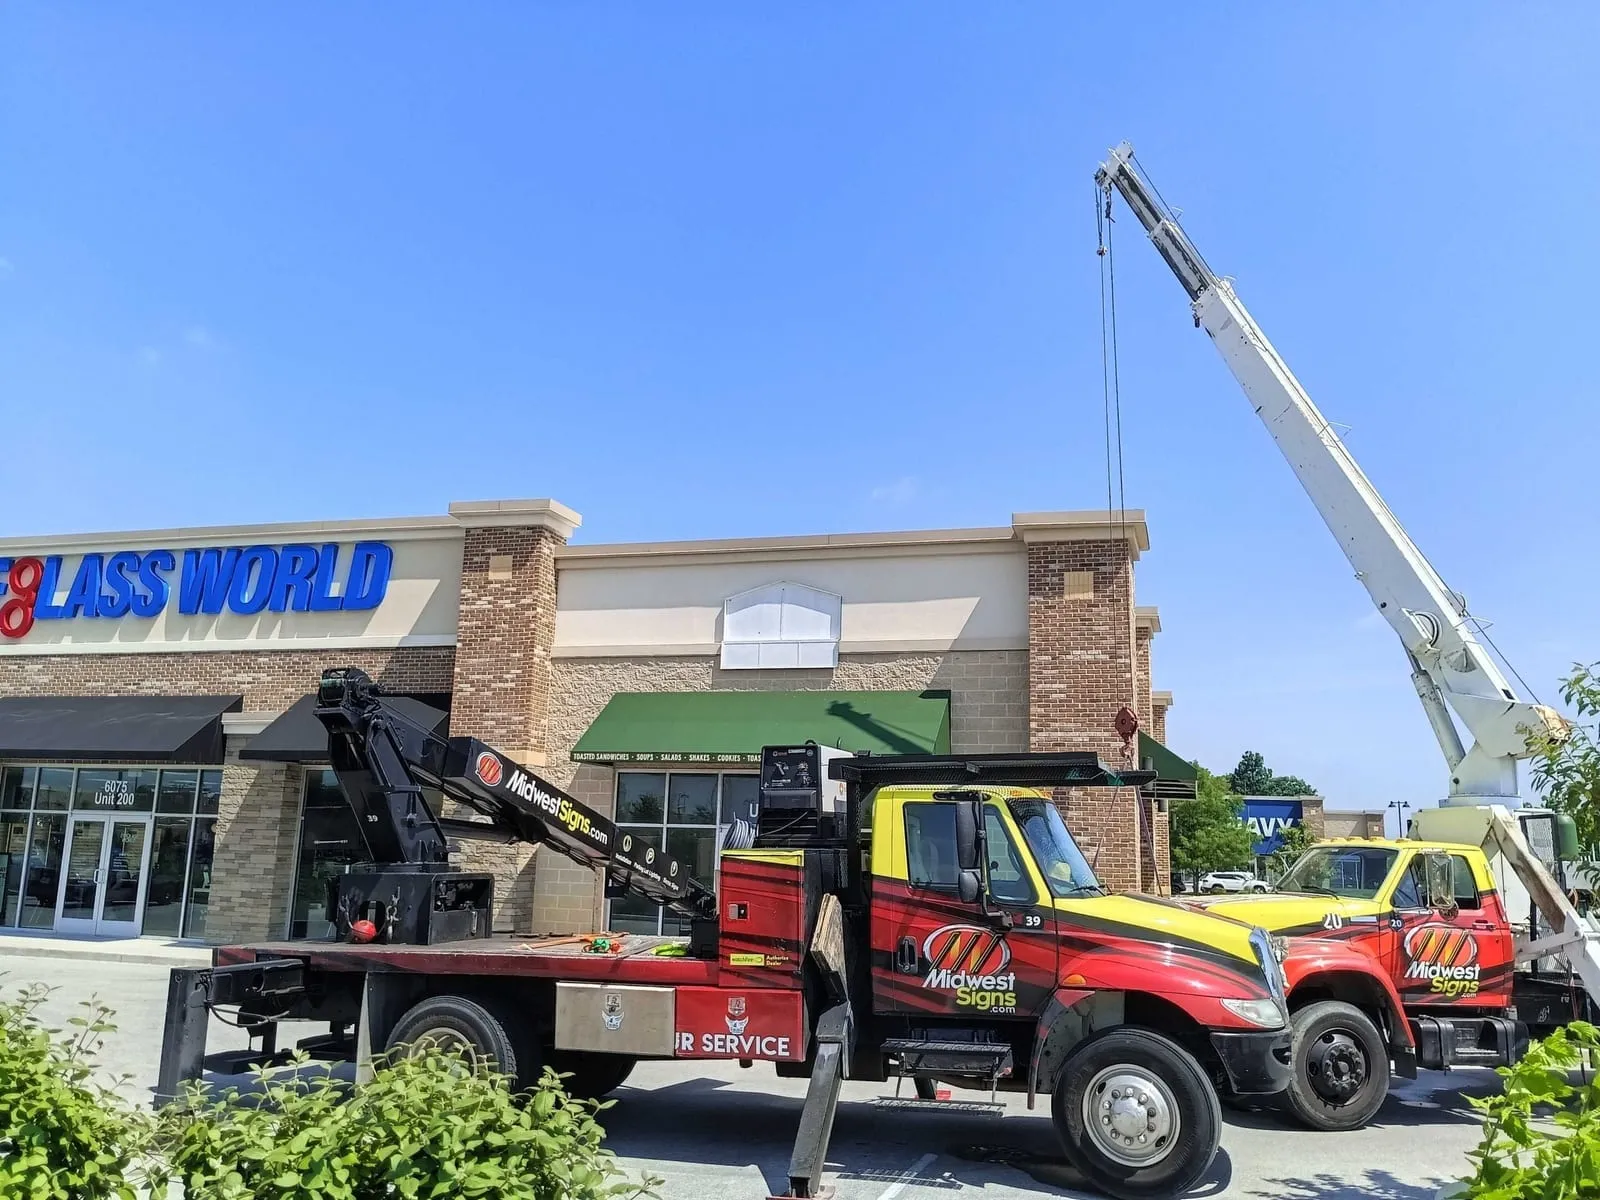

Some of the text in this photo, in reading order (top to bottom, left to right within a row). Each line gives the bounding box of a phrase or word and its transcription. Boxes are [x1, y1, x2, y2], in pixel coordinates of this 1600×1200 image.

[179, 540, 393, 614] WORLD
[596, 753, 629, 761] SANDWICHES
[636, 753, 654, 761] SOUPS
[689, 754, 710, 762] SHAKES
[104, 780, 128, 793] 6075
[94, 792, 135, 805] Unit 200
[505, 769, 608, 845] MidwestSigns.com
[367, 814, 378, 822] 39
[1236, 816, 1293, 837] AVY
[1025, 915, 1041, 927] 39
[1391, 918, 1402, 929] 20
[922, 968, 1016, 991] Midwest
[1404, 960, 1481, 980] Midwest
[1430, 976, 1480, 997] Signs
[956, 986, 1017, 1010] Signs
[989, 1006, 1016, 1014] .com
[702, 1034, 790, 1057] SERVICE
